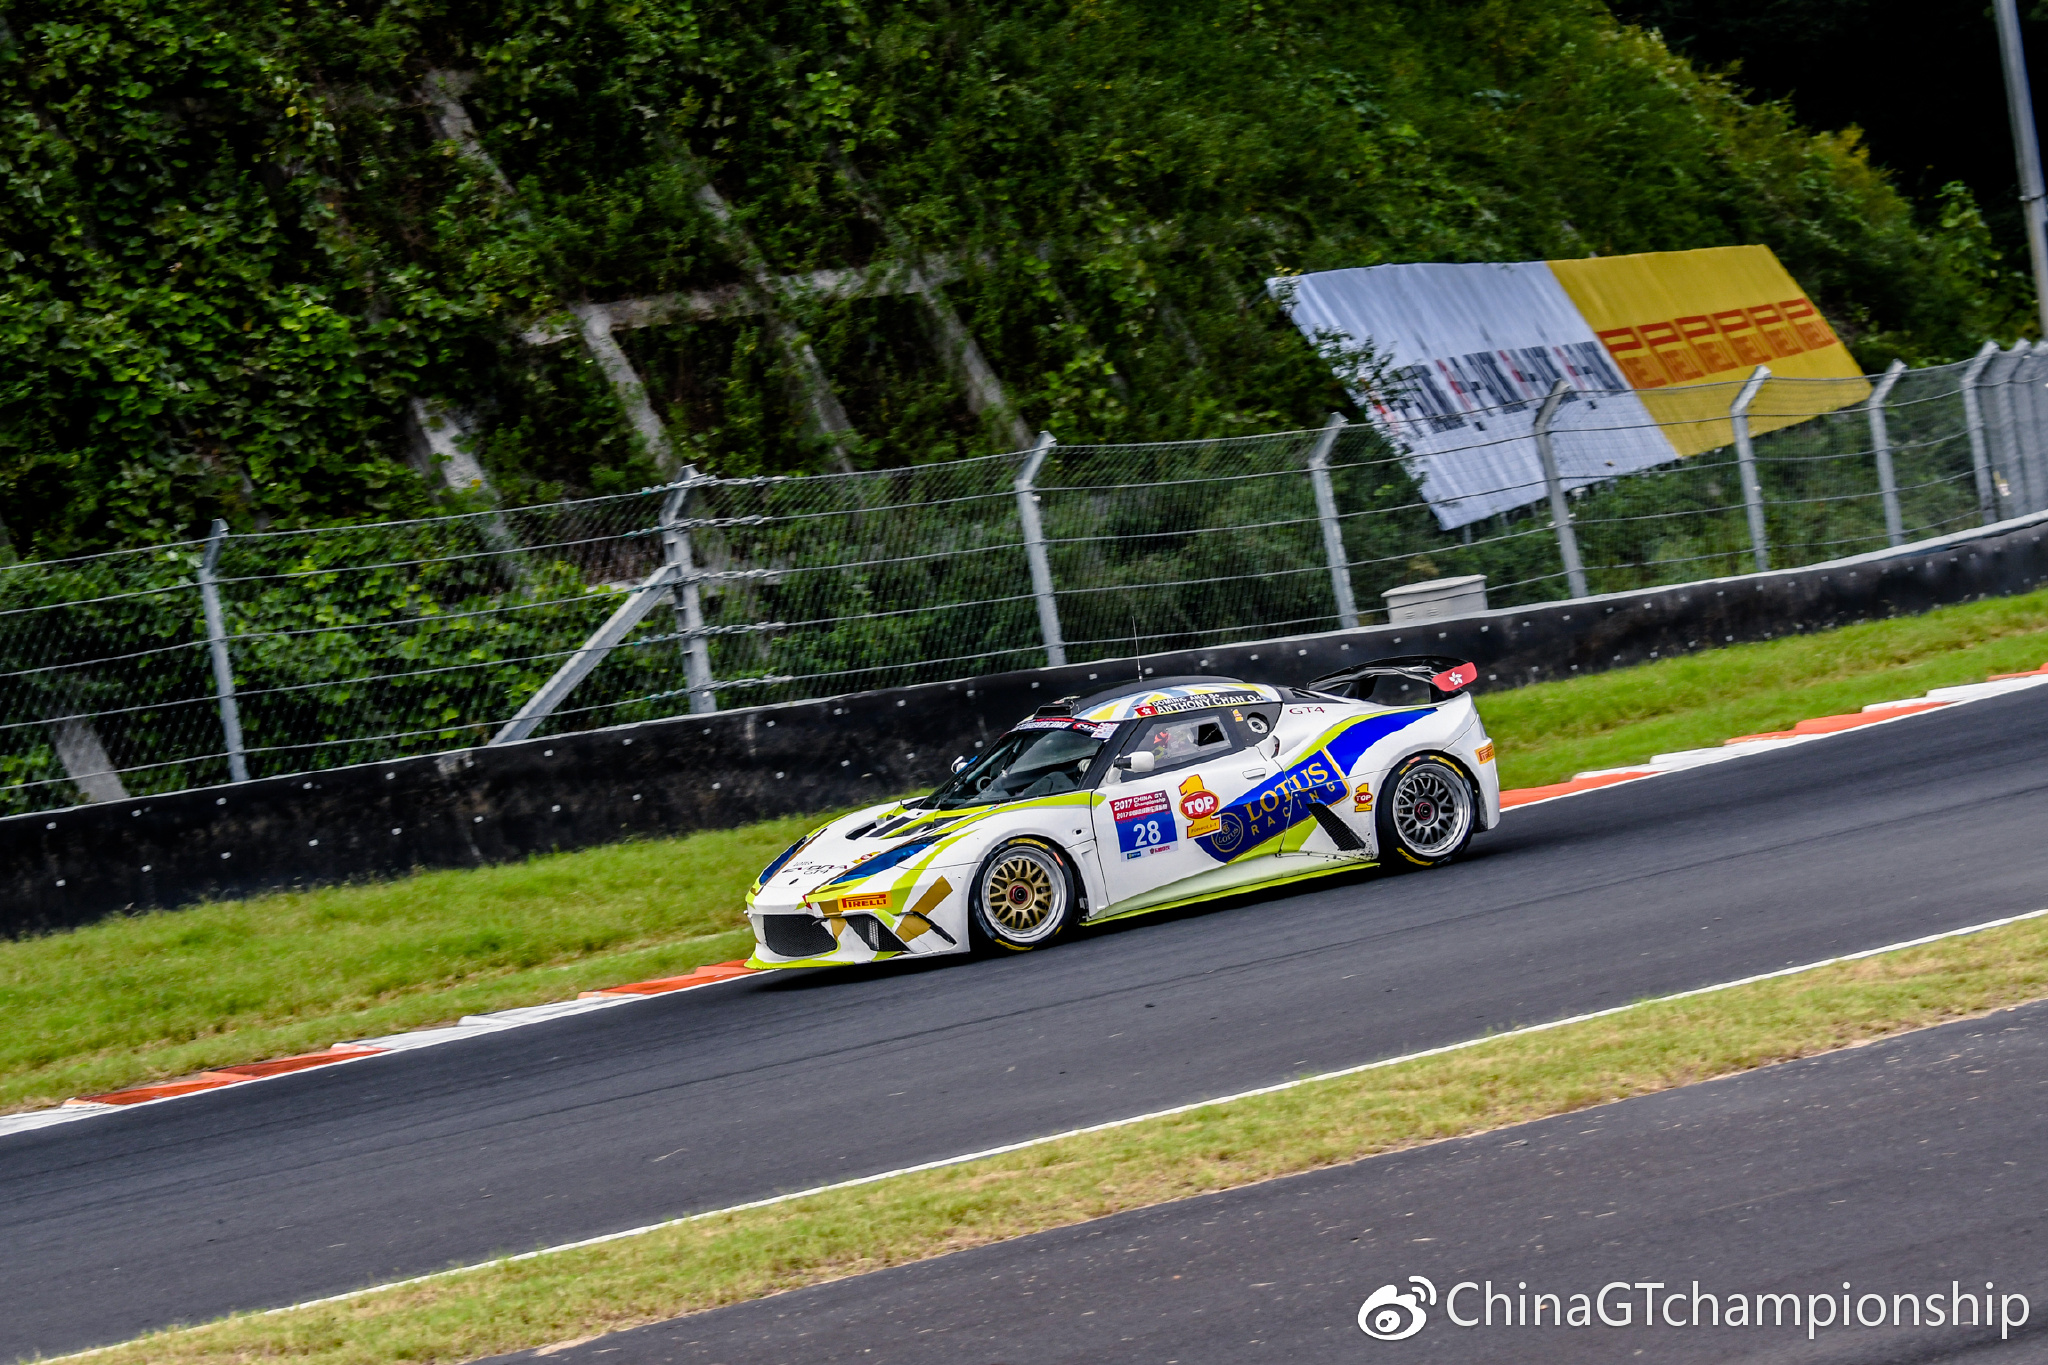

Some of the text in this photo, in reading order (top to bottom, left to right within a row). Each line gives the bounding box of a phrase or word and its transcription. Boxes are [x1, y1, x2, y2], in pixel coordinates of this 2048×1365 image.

[1152, 698, 1187, 707] DOMINIC
[1157, 698, 1211, 712] ANTHONY
[1213, 695, 1245, 705] CHAN
[1478, 745, 1495, 762] PIRELL
[1133, 794, 1153, 803] CHINA
[1243, 762, 1328, 823] LOTUS
[1356, 794, 1372, 802] TOP
[1114, 798, 1132, 811] 2017
[1184, 796, 1214, 815] TOP
[1250, 781, 1336, 836] RACING
[1133, 820, 1161, 847] 28
[1218, 827, 1239, 843] LOTUS
[842, 893, 887, 908] PIRELLI
